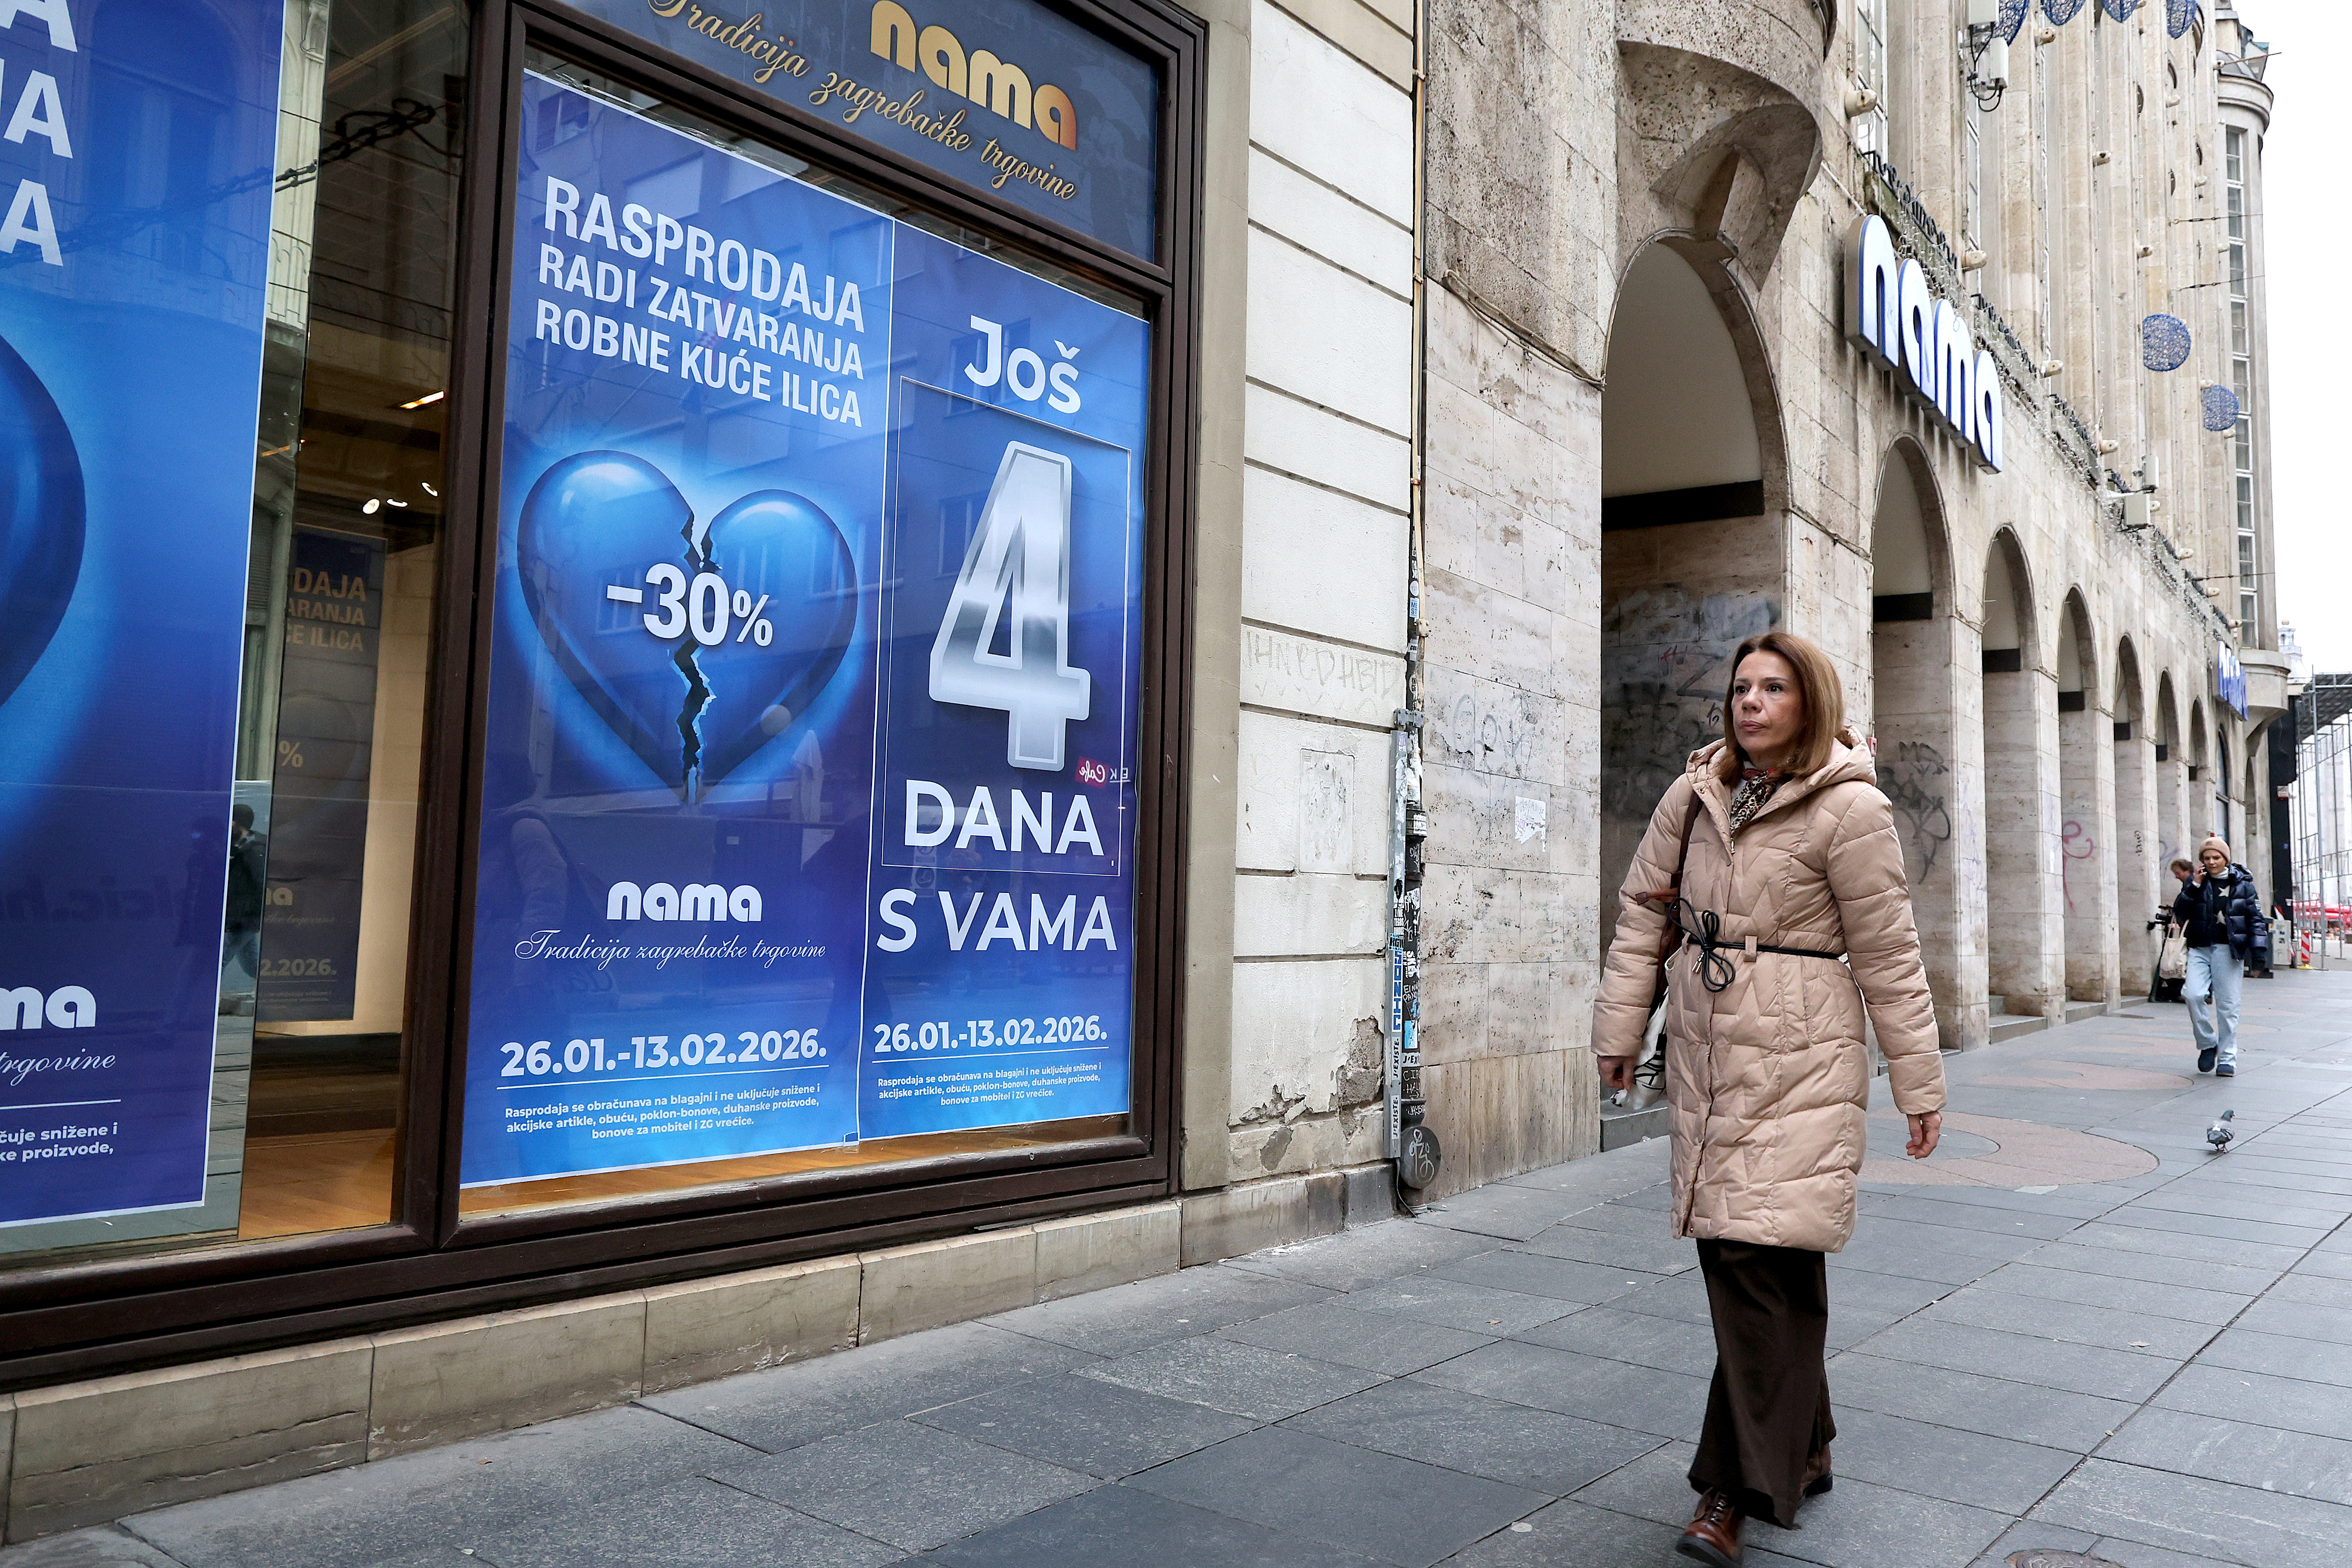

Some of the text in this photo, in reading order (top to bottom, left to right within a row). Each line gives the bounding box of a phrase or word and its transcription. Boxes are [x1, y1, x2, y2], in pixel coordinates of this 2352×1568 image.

[870, 0, 1076, 151] nama
[808, 72, 973, 151] zagrebačke
[981, 137, 1076, 200] trgovine
[544, 175, 865, 333] RASPRODAJA
[539, 242, 864, 380] RADI ZATVARANJA
[536, 298, 863, 428] ROBNE KUĆE ILICA
[1857, 215, 2003, 473] nama
[929, 440, 1090, 771] 4
[310, 627, 363, 652] ILICA
[904, 779, 1104, 856] DANA
[606, 881, 762, 922] nama
[876, 889, 1117, 952] S VAMA
[514, 930, 826, 970] Tradicija zagrebačke trgovine
[500, 1028, 827, 1077] 26.01.-13.02.2026.
[874, 1015, 1107, 1053] 26.01.-13.02.2026.
[878, 1075, 924, 1088] Rasprodaja
[938, 1072, 981, 1082] obračunava
[995, 1068, 1024, 1079] blagajni
[1041, 1064, 1073, 1076] uključuje
[1073, 1063, 1098, 1072] snižene
[878, 1074, 1101, 1099] akcijske artikle, obuću, poklon-bonove, duhanske proizvode,
[505, 1102, 569, 1119] Rasprodaja
[572, 1104, 584, 1113] se
[587, 1098, 652, 1111] obračunava
[670, 1092, 713, 1106] blagajni
[714, 1091, 718, 1101] i
[720, 1092, 734, 1101] ne
[737, 1087, 780, 1101] uključuje
[781, 1085, 815, 1095] snižene
[817, 1083, 820, 1092] i
[506, 1096, 820, 1133] akcijske artikle, obuću, poklon-bonove, duhanske proizvode,
[941, 1096, 970, 1106] bonove
[980, 1092, 1011, 1102] mobitel
[1015, 1091, 1025, 1099] ZG
[1026, 1088, 1054, 1098] vrećice.
[41, 1125, 108, 1141] snižene
[112, 1122, 118, 1135] i
[592, 1116, 754, 1139] bonove za mobitel i ZG vrećice.
[22, 1141, 114, 1162] proizvode,
